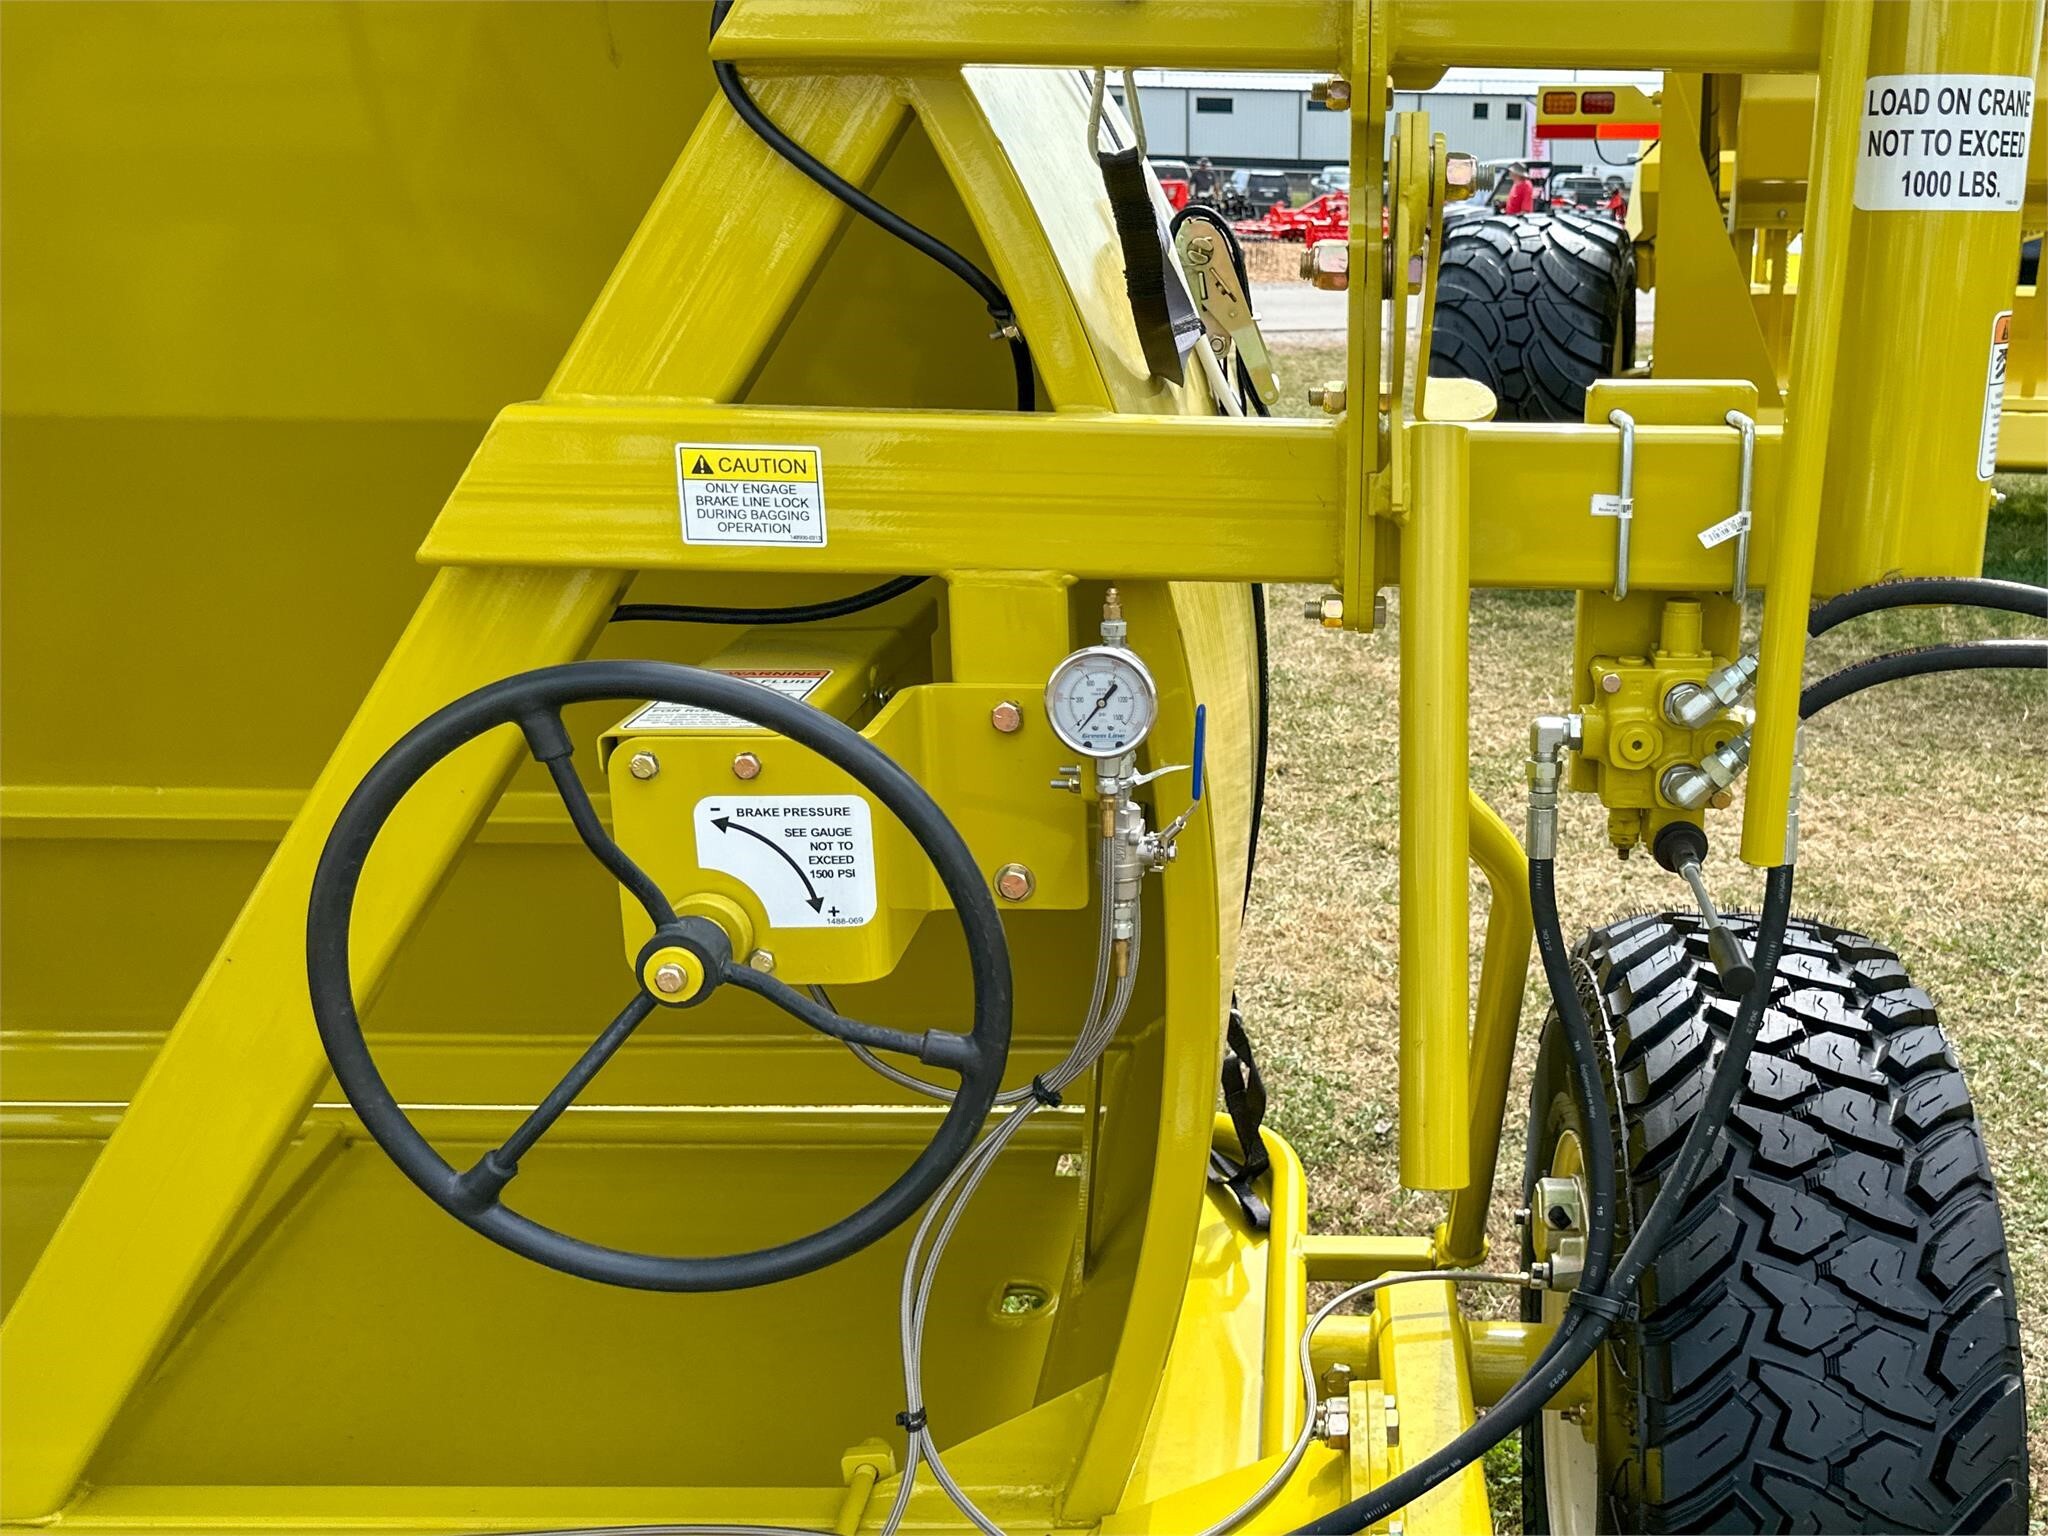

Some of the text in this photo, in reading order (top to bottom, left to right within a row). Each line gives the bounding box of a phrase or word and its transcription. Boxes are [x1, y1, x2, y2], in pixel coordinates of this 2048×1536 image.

[1868, 87, 2031, 117] LOAD ON CRANE
[1868, 129, 2026, 158] NOT TO EXCEED
[1901, 170, 2001, 198] 1000 LBS.
[718, 456, 807, 474] CAUTION
[705, 482, 797, 495] ONLY ENGAGE
[696, 495, 809, 508] BRAKE LINE LOCK
[697, 508, 810, 521] DURING BAGGING
[717, 521, 791, 534] OPERATION
[736, 806, 851, 817] BRAKE PRESSURE
[784, 827, 852, 837] SEE GAUGE
[810, 841, 853, 851] NOT TO
[808, 855, 854, 865] EXCEED
[810, 869, 856, 879] 1500 PSI
[826, 916, 864, 925] 1488-069
[1596, 1205, 1604, 1217] 15
